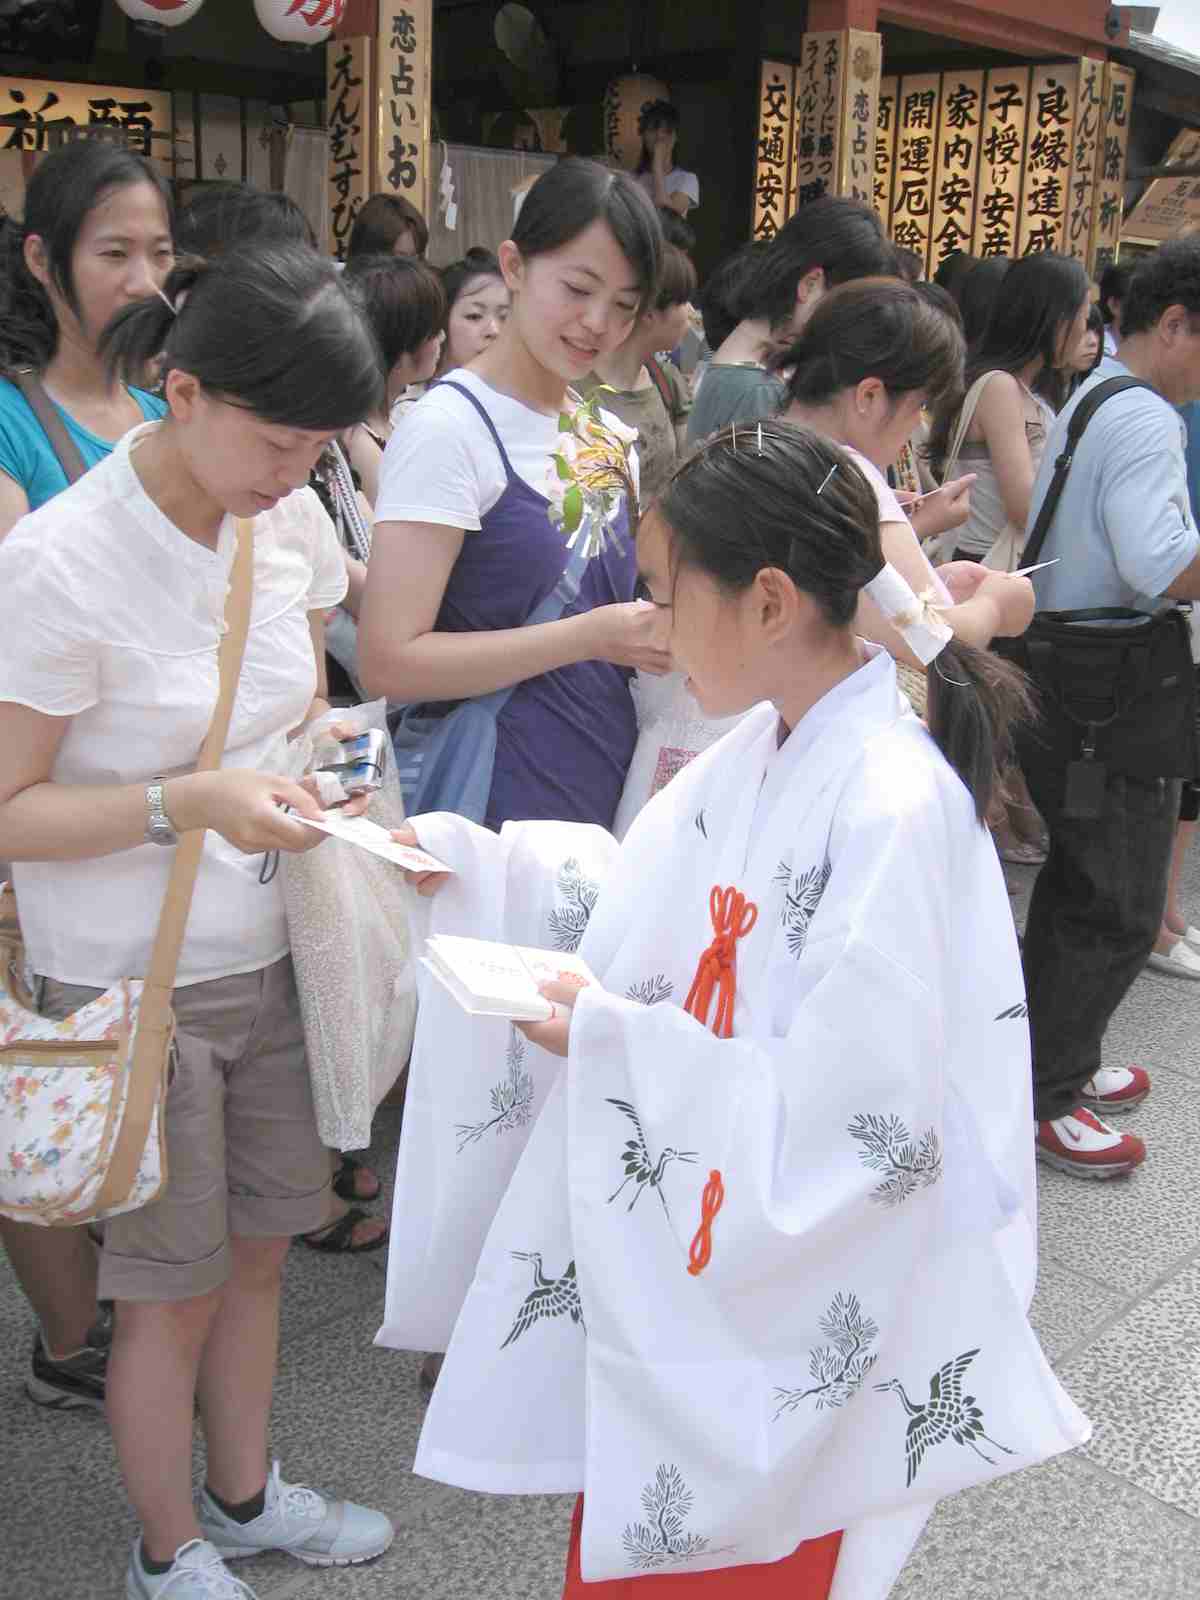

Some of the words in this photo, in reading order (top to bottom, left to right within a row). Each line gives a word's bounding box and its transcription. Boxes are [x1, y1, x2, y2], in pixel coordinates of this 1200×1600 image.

[387, 8, 419, 190] 恋占いお
[933, 83, 979, 257] 家内安全
[980, 83, 1024, 258] 子授け安産
[1020, 77, 1072, 256] 良縁達成
